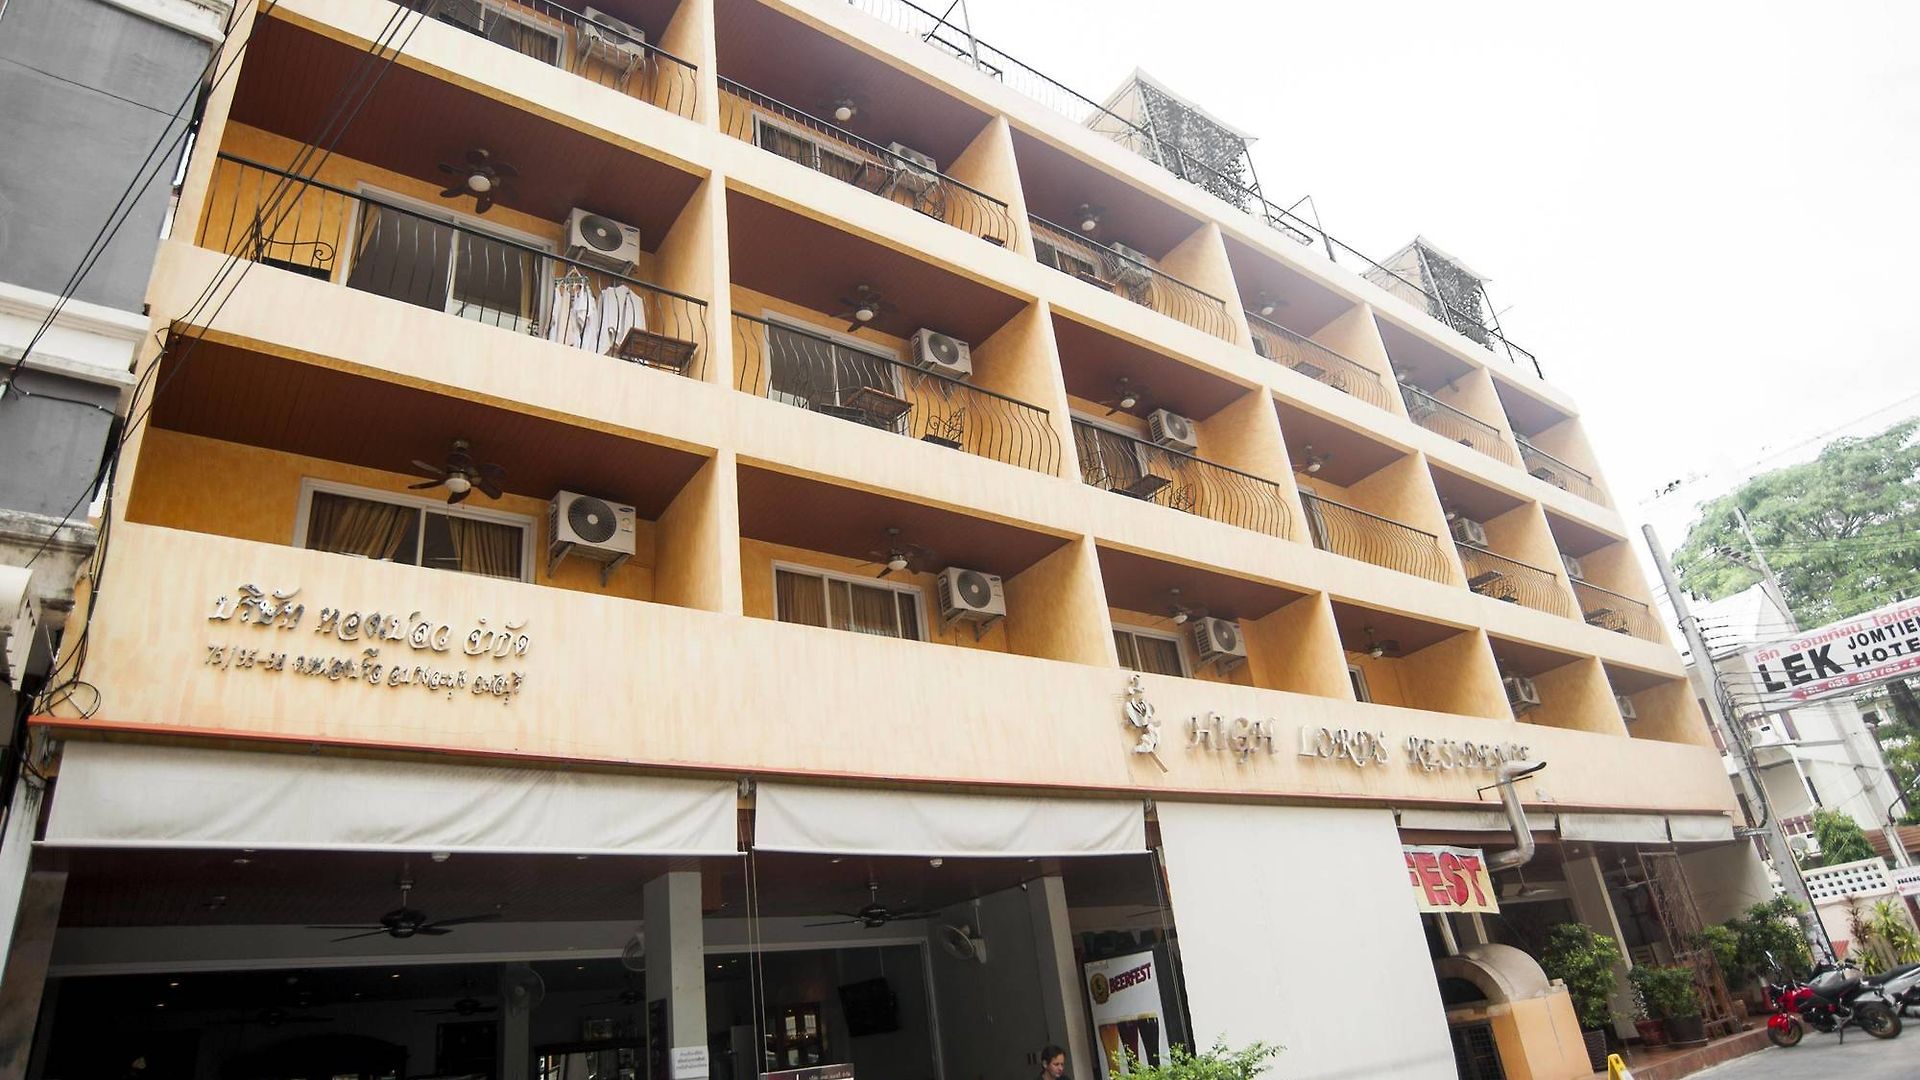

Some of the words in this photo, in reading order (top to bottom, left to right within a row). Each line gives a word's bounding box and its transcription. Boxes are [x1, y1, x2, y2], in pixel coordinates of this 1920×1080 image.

[208, 583, 304, 630] บริษัท
[463, 615, 530, 658] จำกัด
[1757, 643, 1845, 692] LEK
[1185, 711, 1279, 765] HIGH
[1298, 726, 1391, 768] LORDS
[1405, 735, 1529, 772] RESIDENCE
[1109, 961, 1152, 994] BEERFEST
